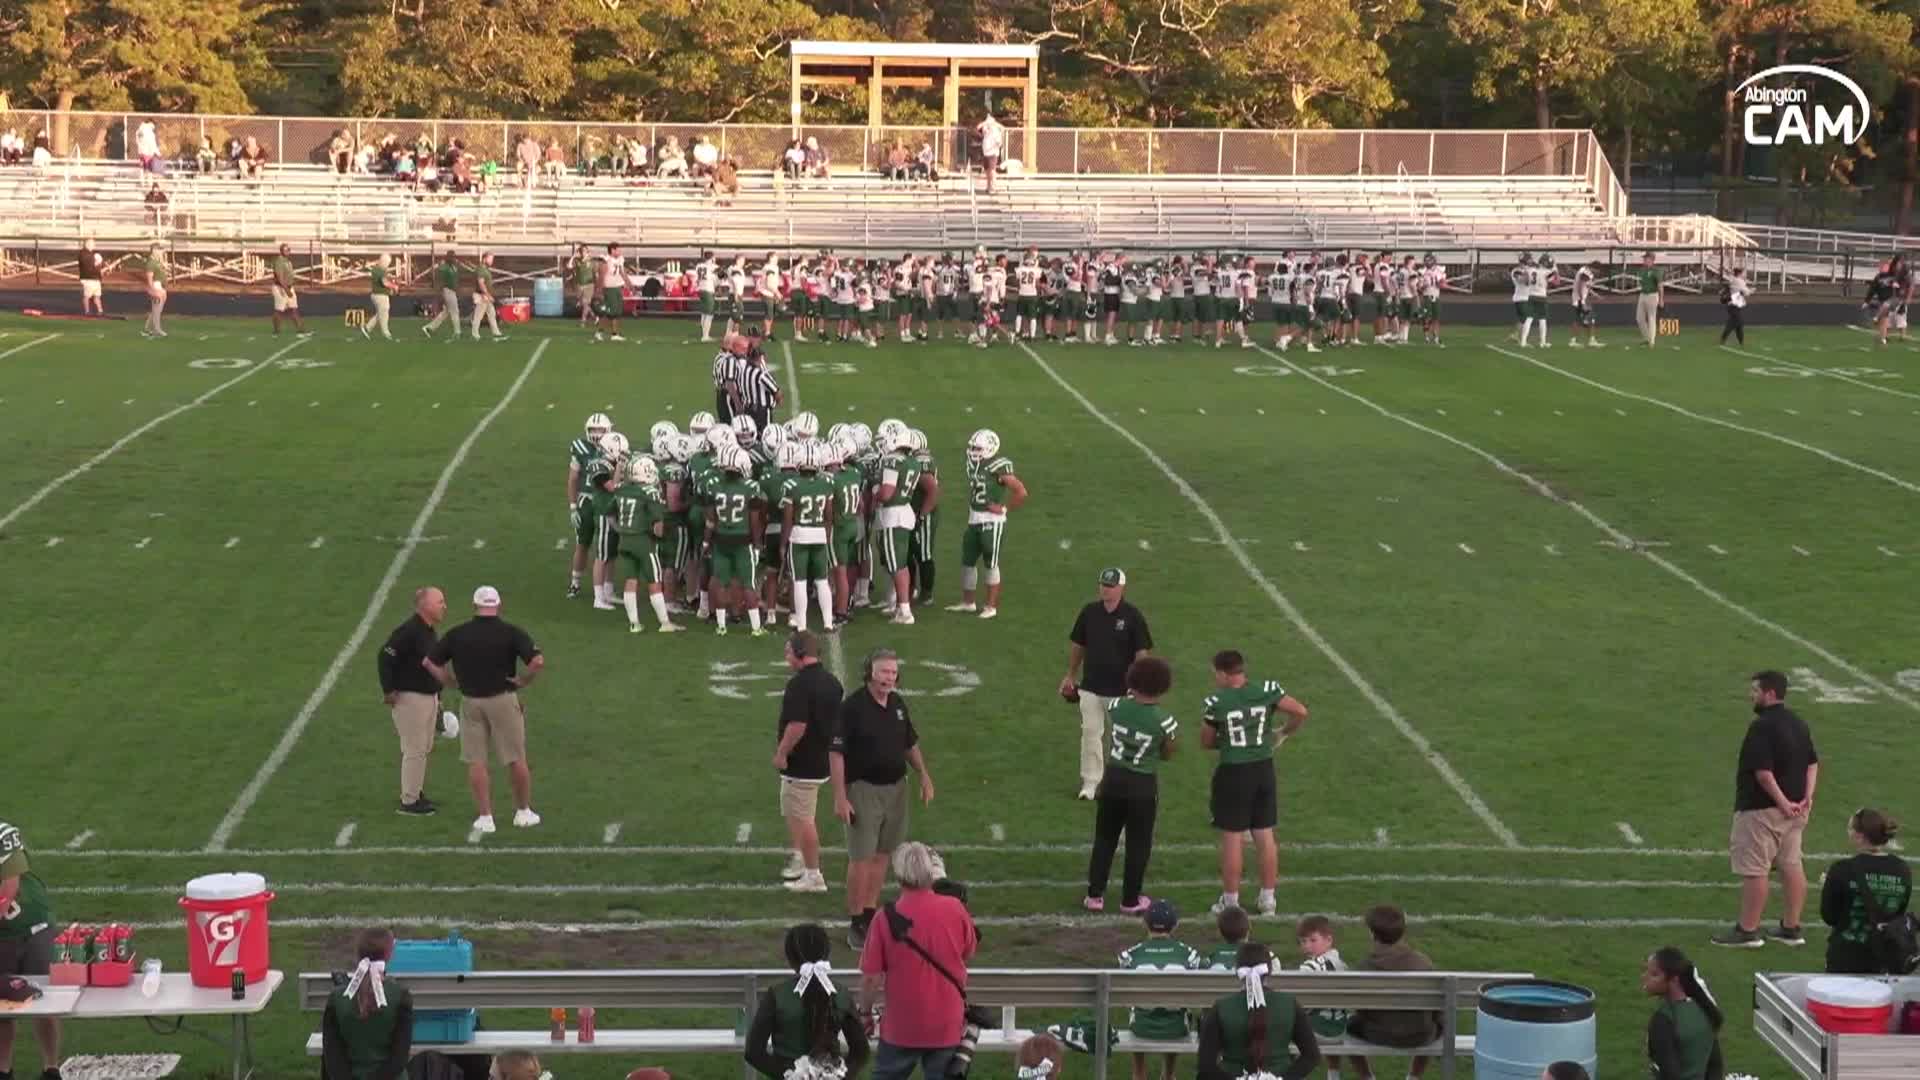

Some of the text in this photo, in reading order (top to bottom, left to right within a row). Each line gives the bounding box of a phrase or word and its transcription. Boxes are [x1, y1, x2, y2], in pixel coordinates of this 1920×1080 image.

[619, 496, 638, 528] 17
[715, 492, 745, 523] 22
[842, 483, 859, 515] 10
[1226, 705, 1267, 748] 67
[1110, 723, 1153, 765] 57
[210, 914, 235, 941] G
